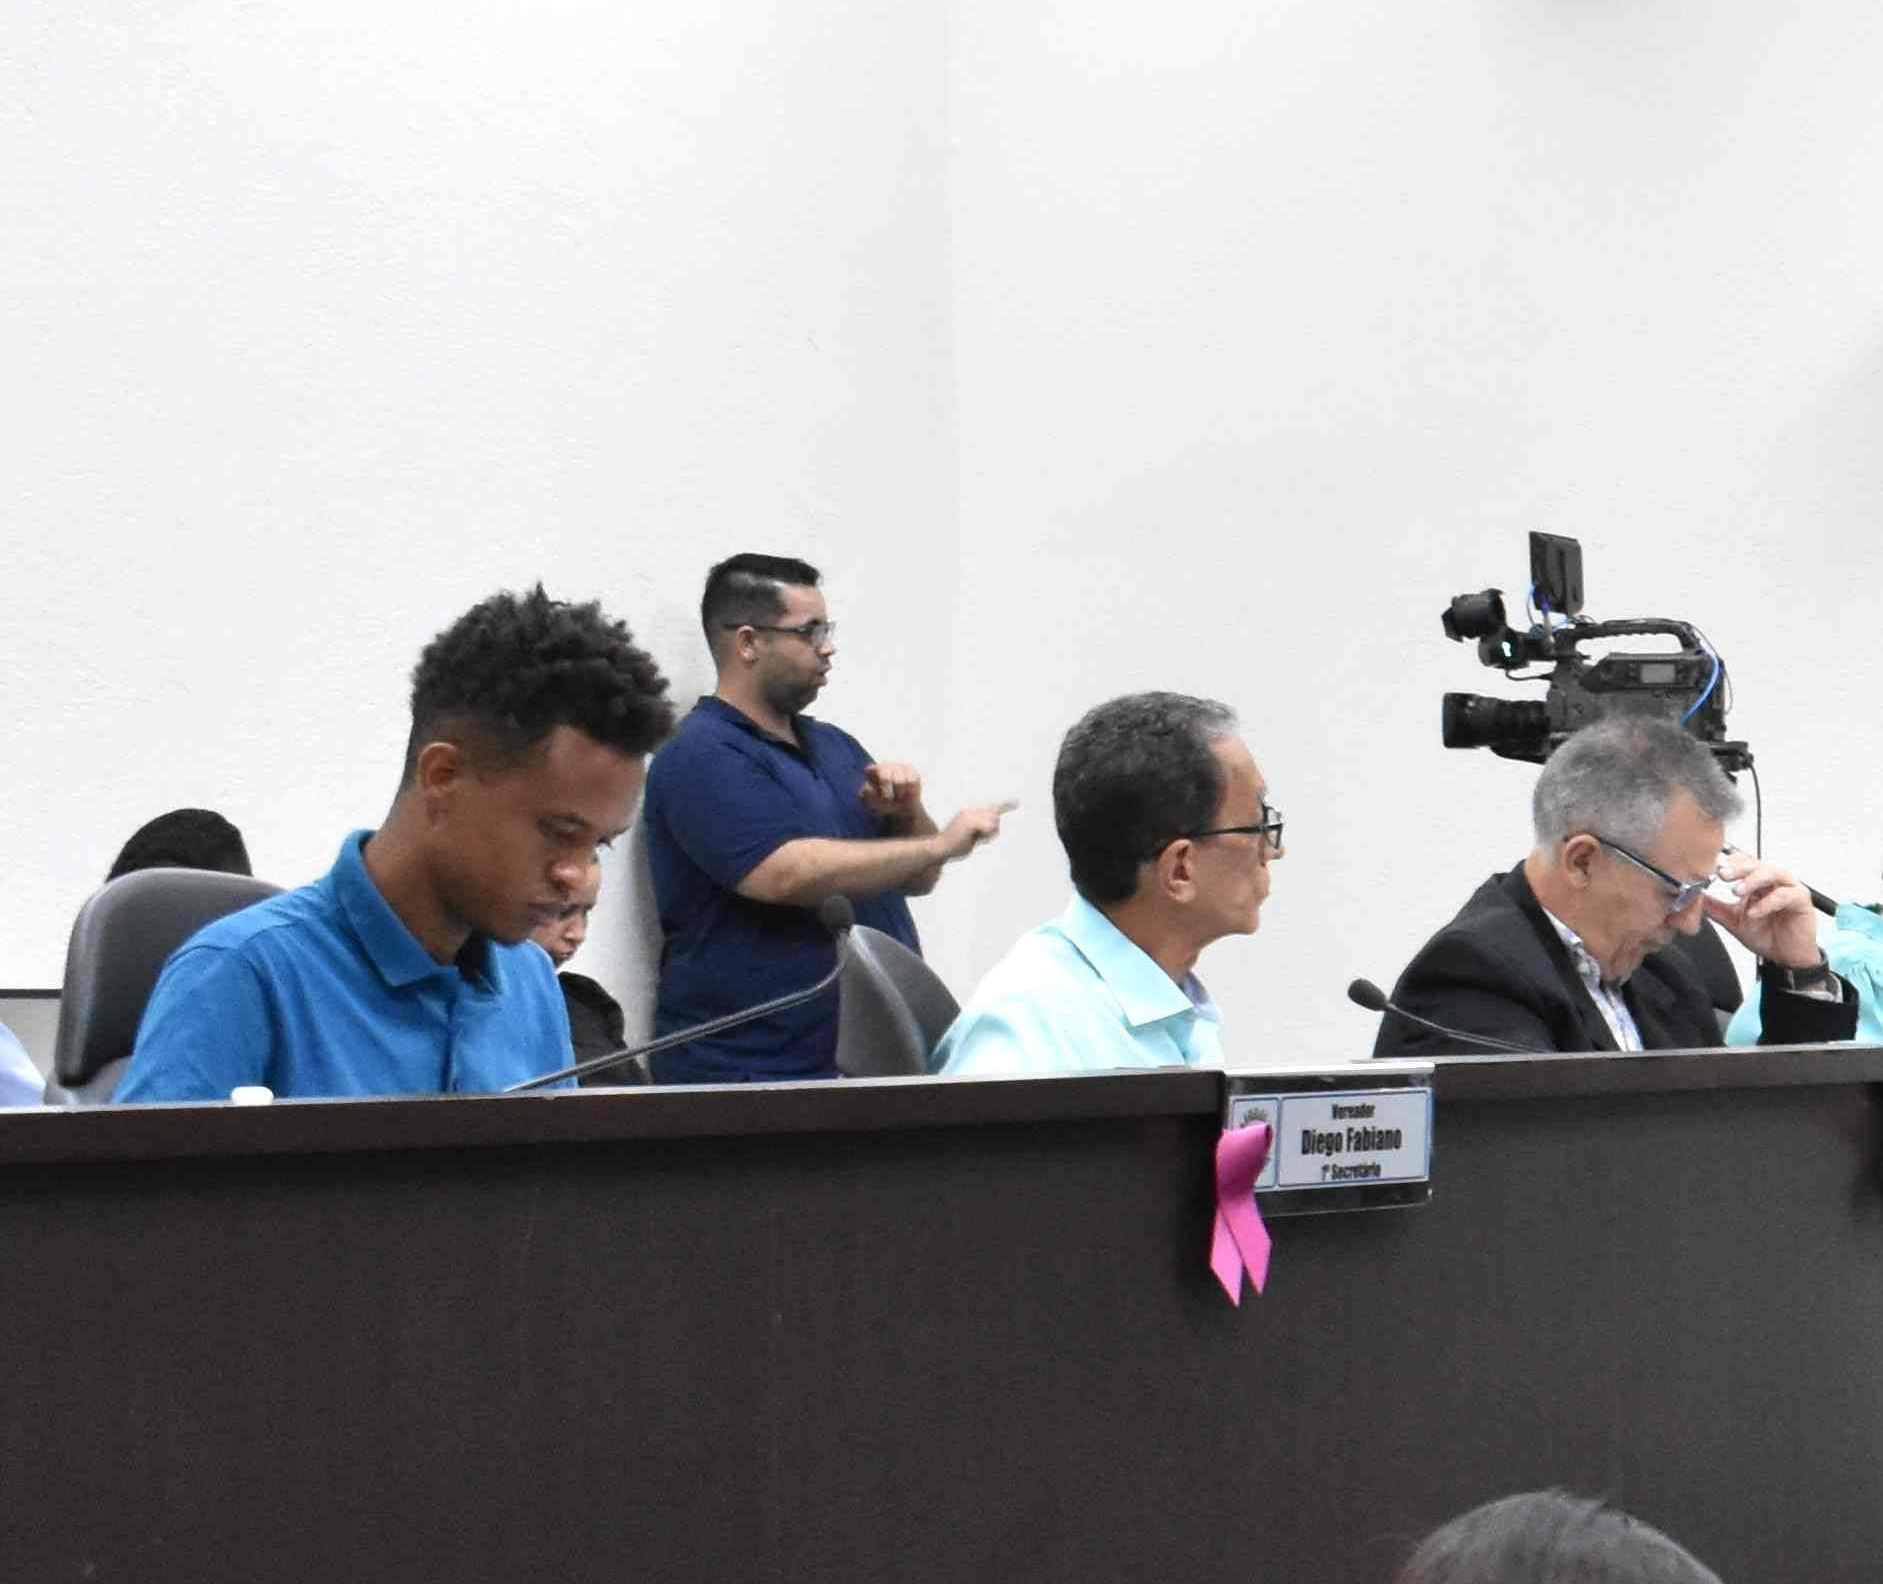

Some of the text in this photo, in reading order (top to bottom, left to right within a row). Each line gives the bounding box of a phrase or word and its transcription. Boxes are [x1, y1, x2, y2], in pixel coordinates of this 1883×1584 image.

[1331, 1103, 1376, 1119] Vereador
[1301, 1126, 1403, 1156] Diego Fabiano
